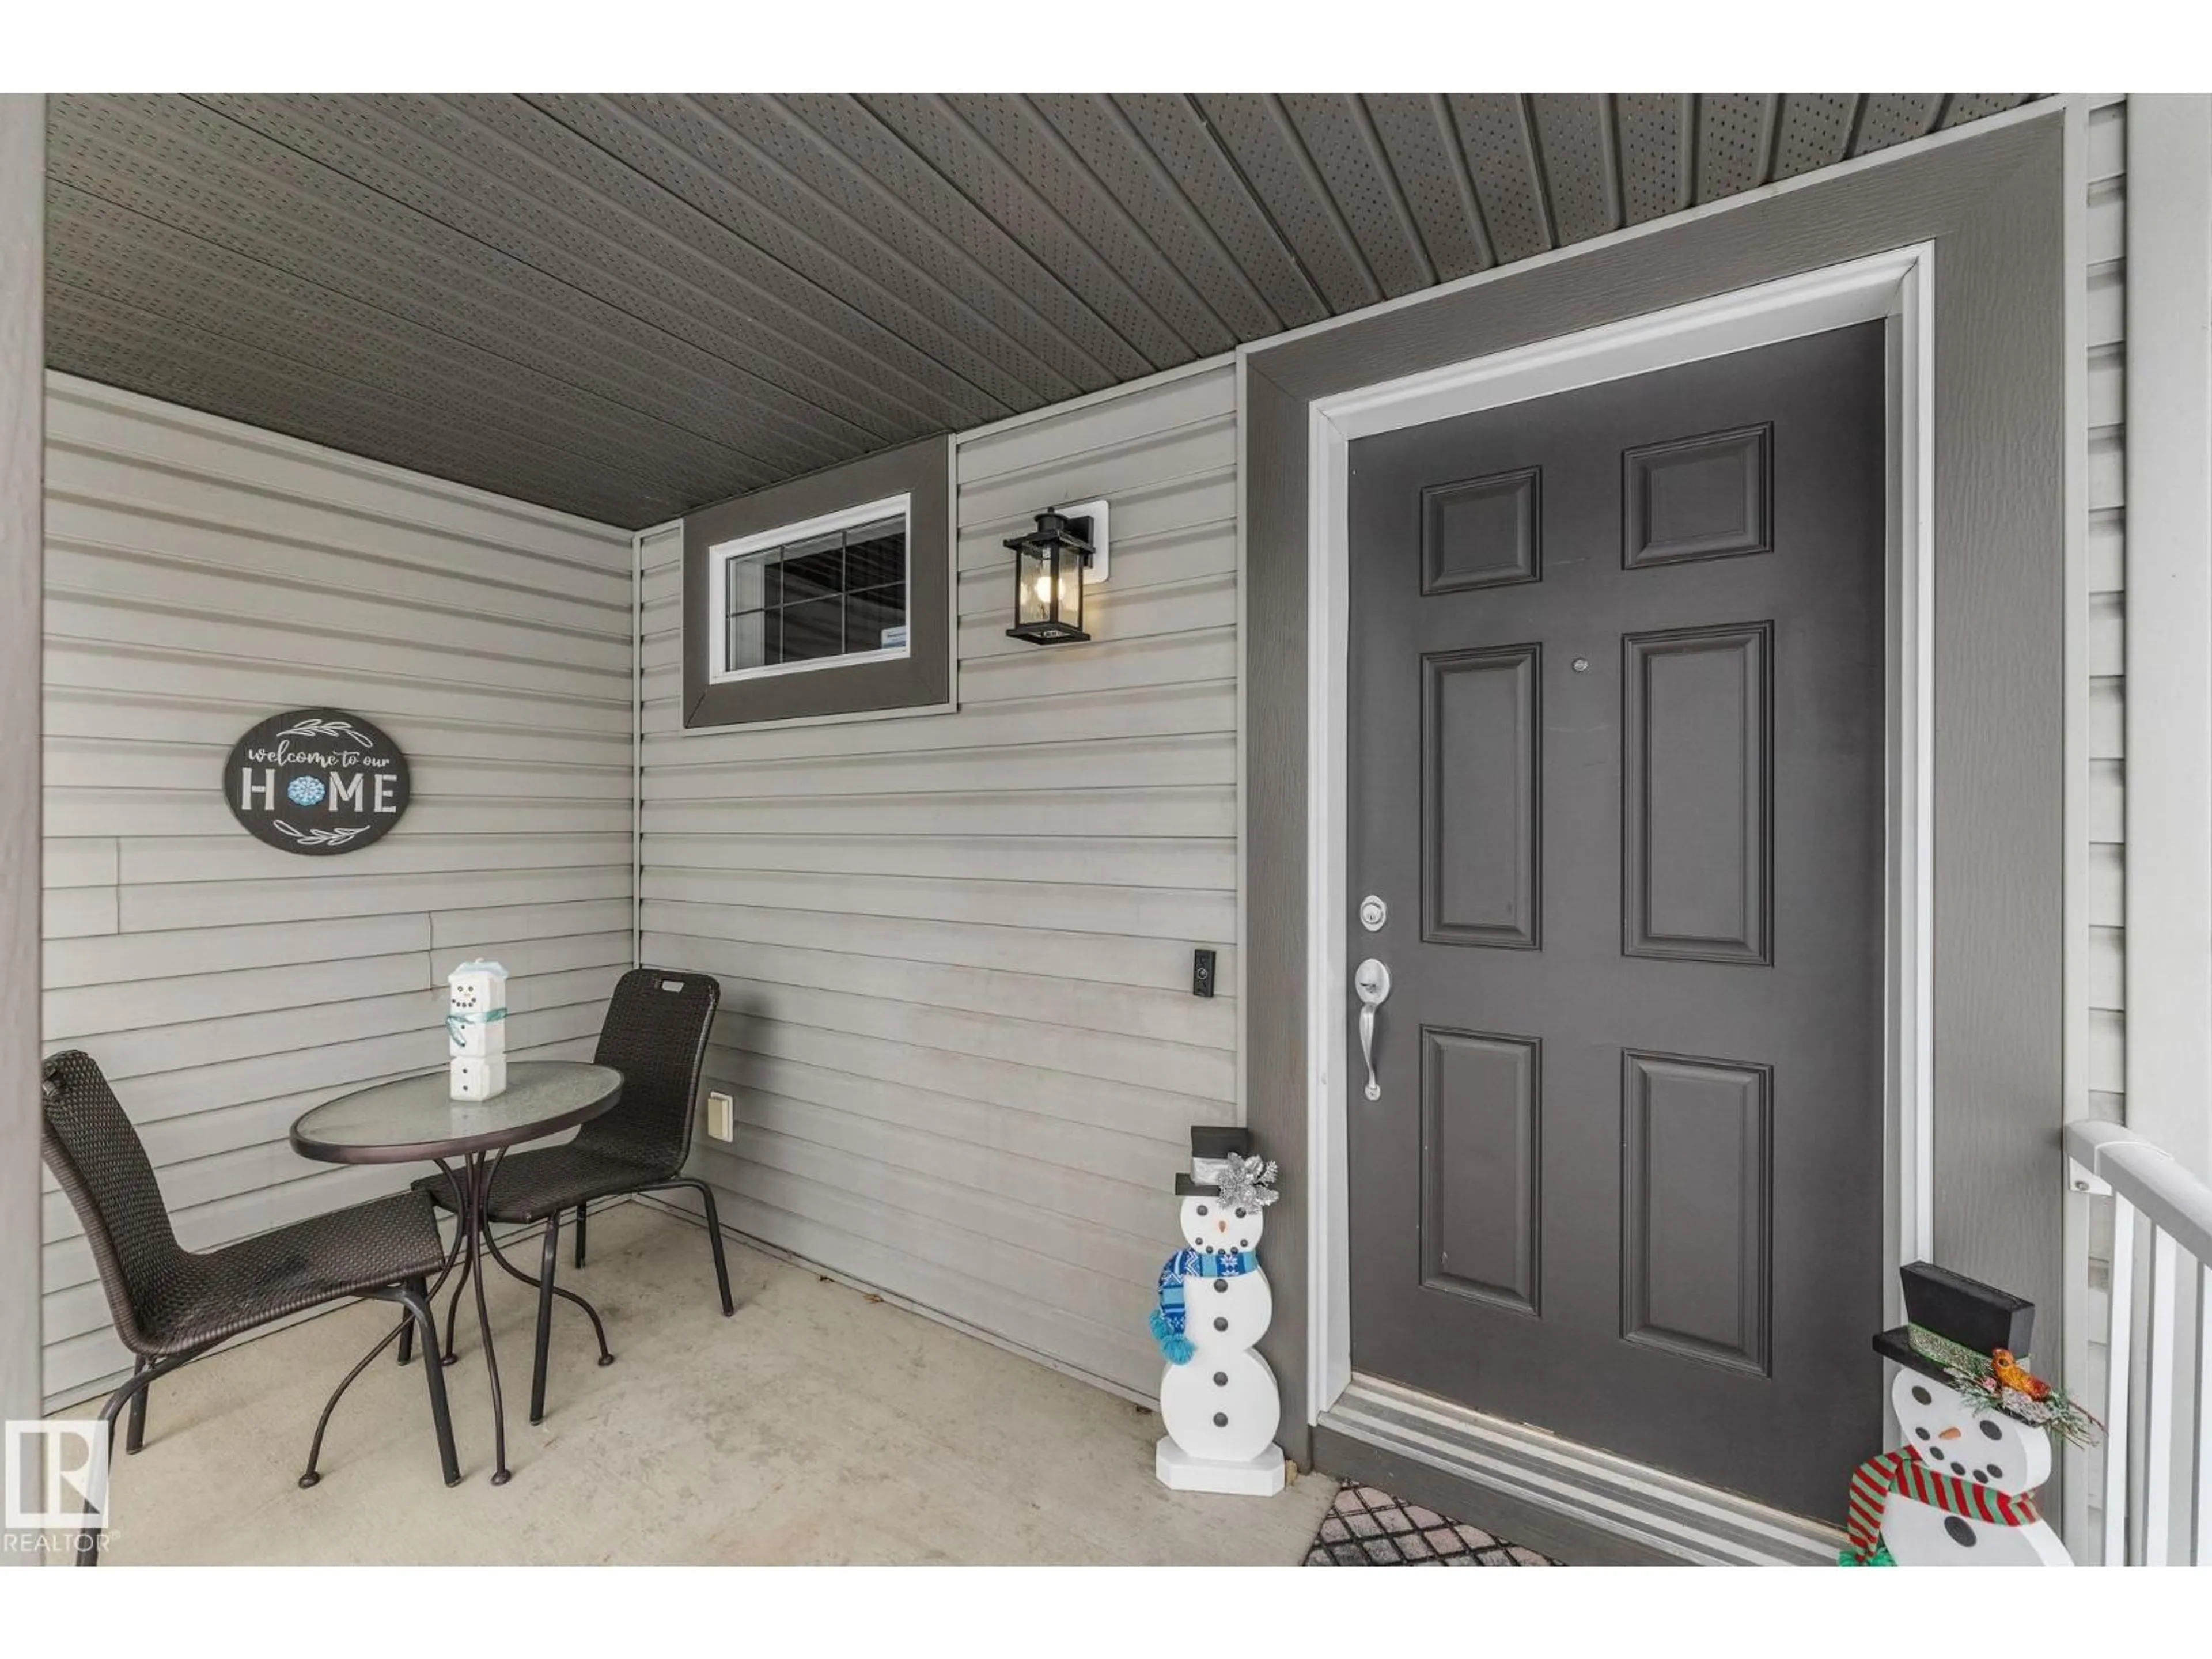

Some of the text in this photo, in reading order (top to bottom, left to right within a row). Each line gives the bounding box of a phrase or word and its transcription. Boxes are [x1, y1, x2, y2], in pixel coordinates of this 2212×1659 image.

[248, 740, 390, 768] welcome to our
